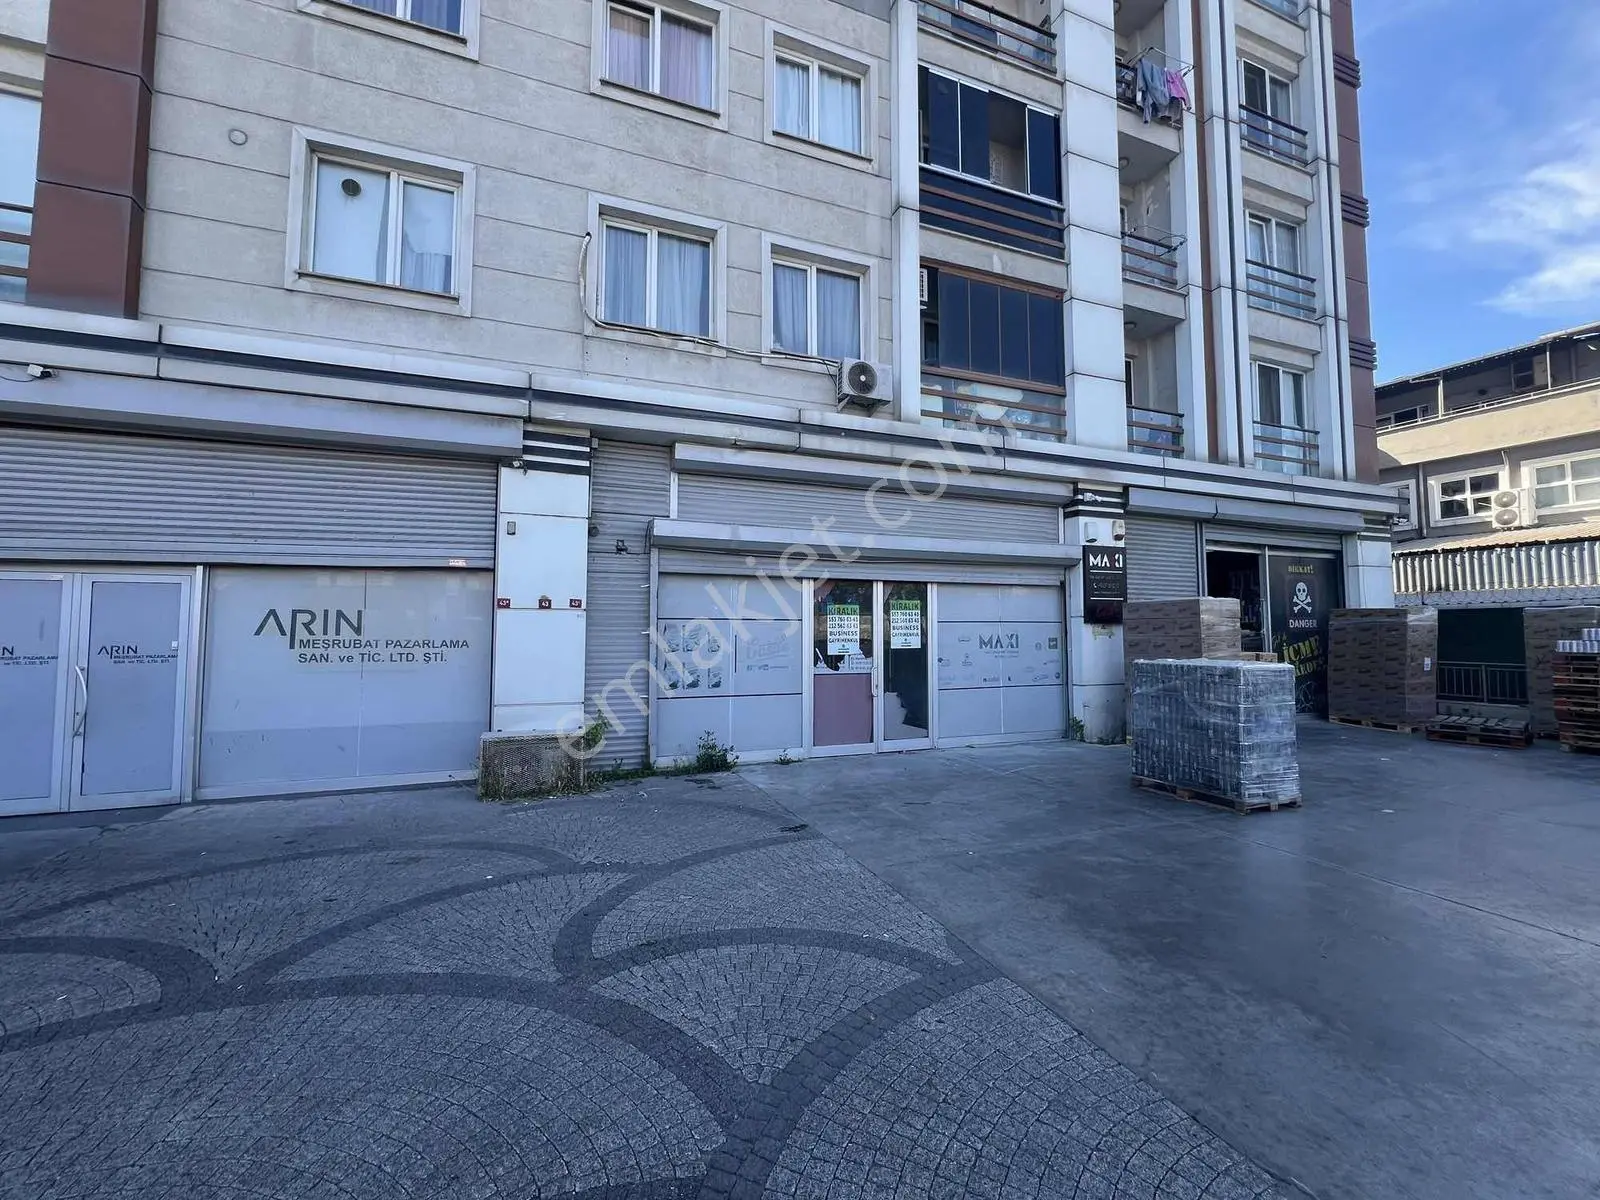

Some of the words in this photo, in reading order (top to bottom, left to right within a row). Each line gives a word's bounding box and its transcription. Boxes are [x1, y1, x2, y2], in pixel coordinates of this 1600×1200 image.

[253, 608, 363, 650] ARIN
[1289, 619, 1318, 629] DANGER
[299, 639, 379, 652] MEŞRUBAT
[385, 639, 469, 649] PAZARLAMA
[979, 634, 1019, 649] MAXI
[97, 645, 138, 660] ARIN
[298, 653, 333, 664] SAN.
[338, 655, 354, 663] ve
[359, 651, 385, 663] TİC.
[390, 652, 418, 663] LTD.
[423, 650, 448, 665] ŞTİ.
